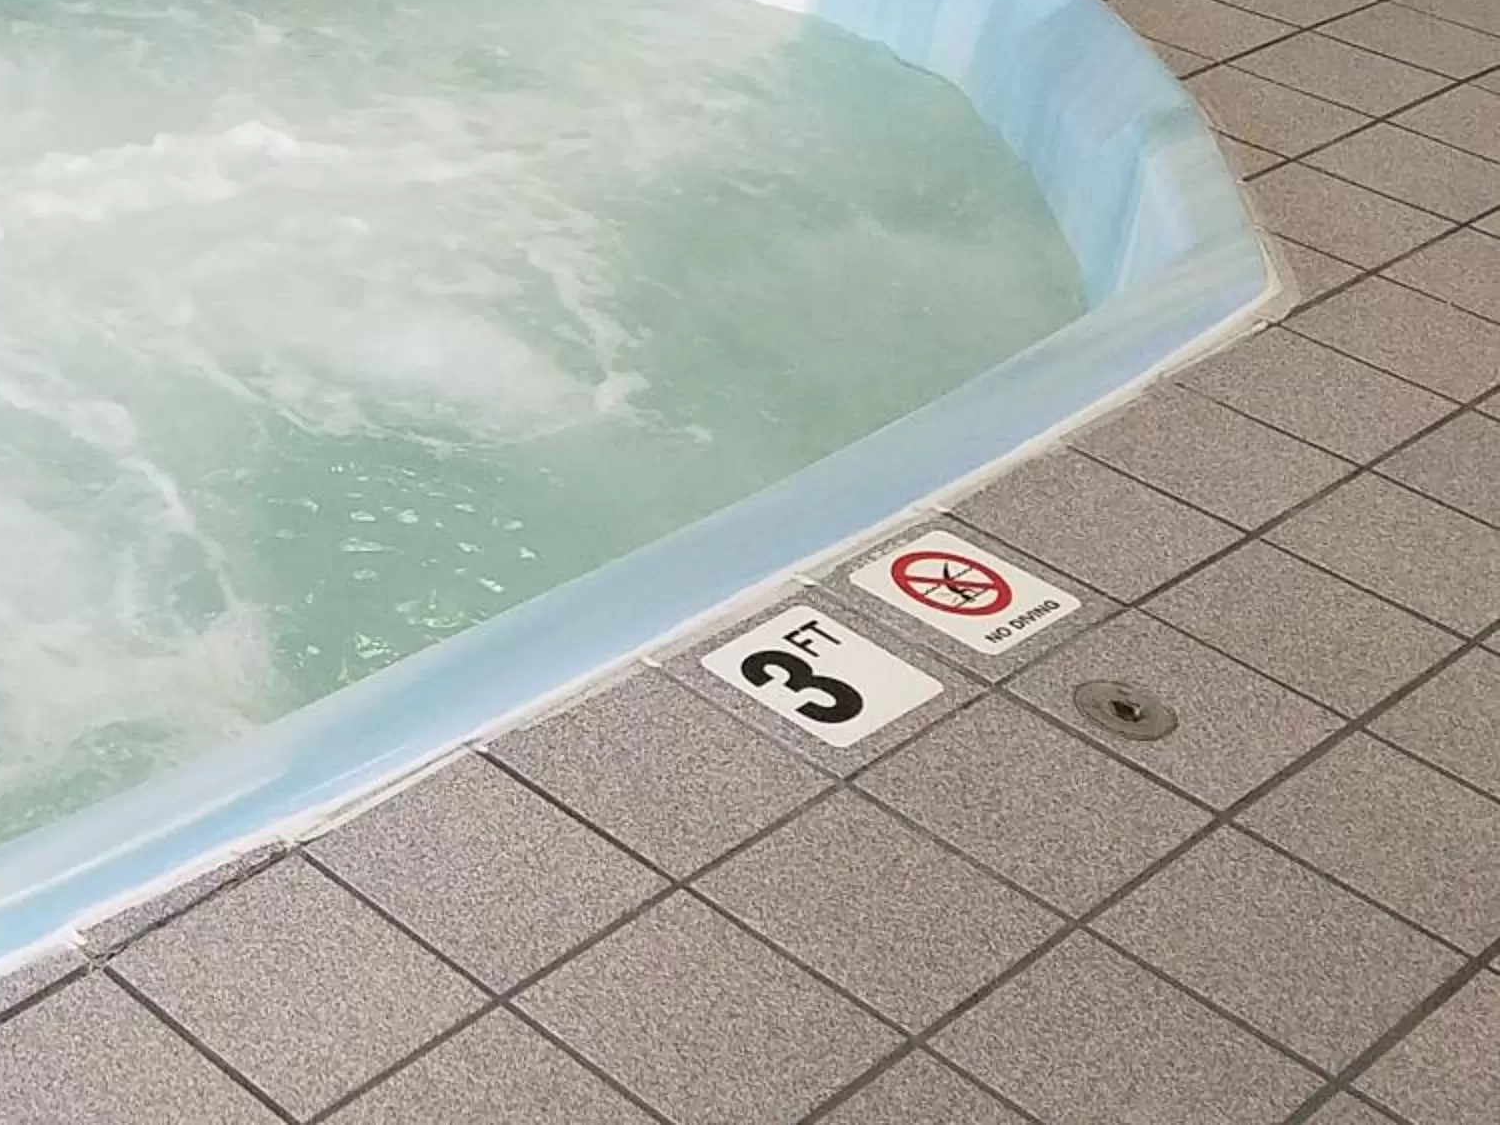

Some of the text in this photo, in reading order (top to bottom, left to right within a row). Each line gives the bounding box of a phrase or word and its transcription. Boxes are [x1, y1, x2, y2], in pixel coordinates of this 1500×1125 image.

[985, 599, 1061, 644] NO DIVING
[740, 619, 864, 724] 3 FT
